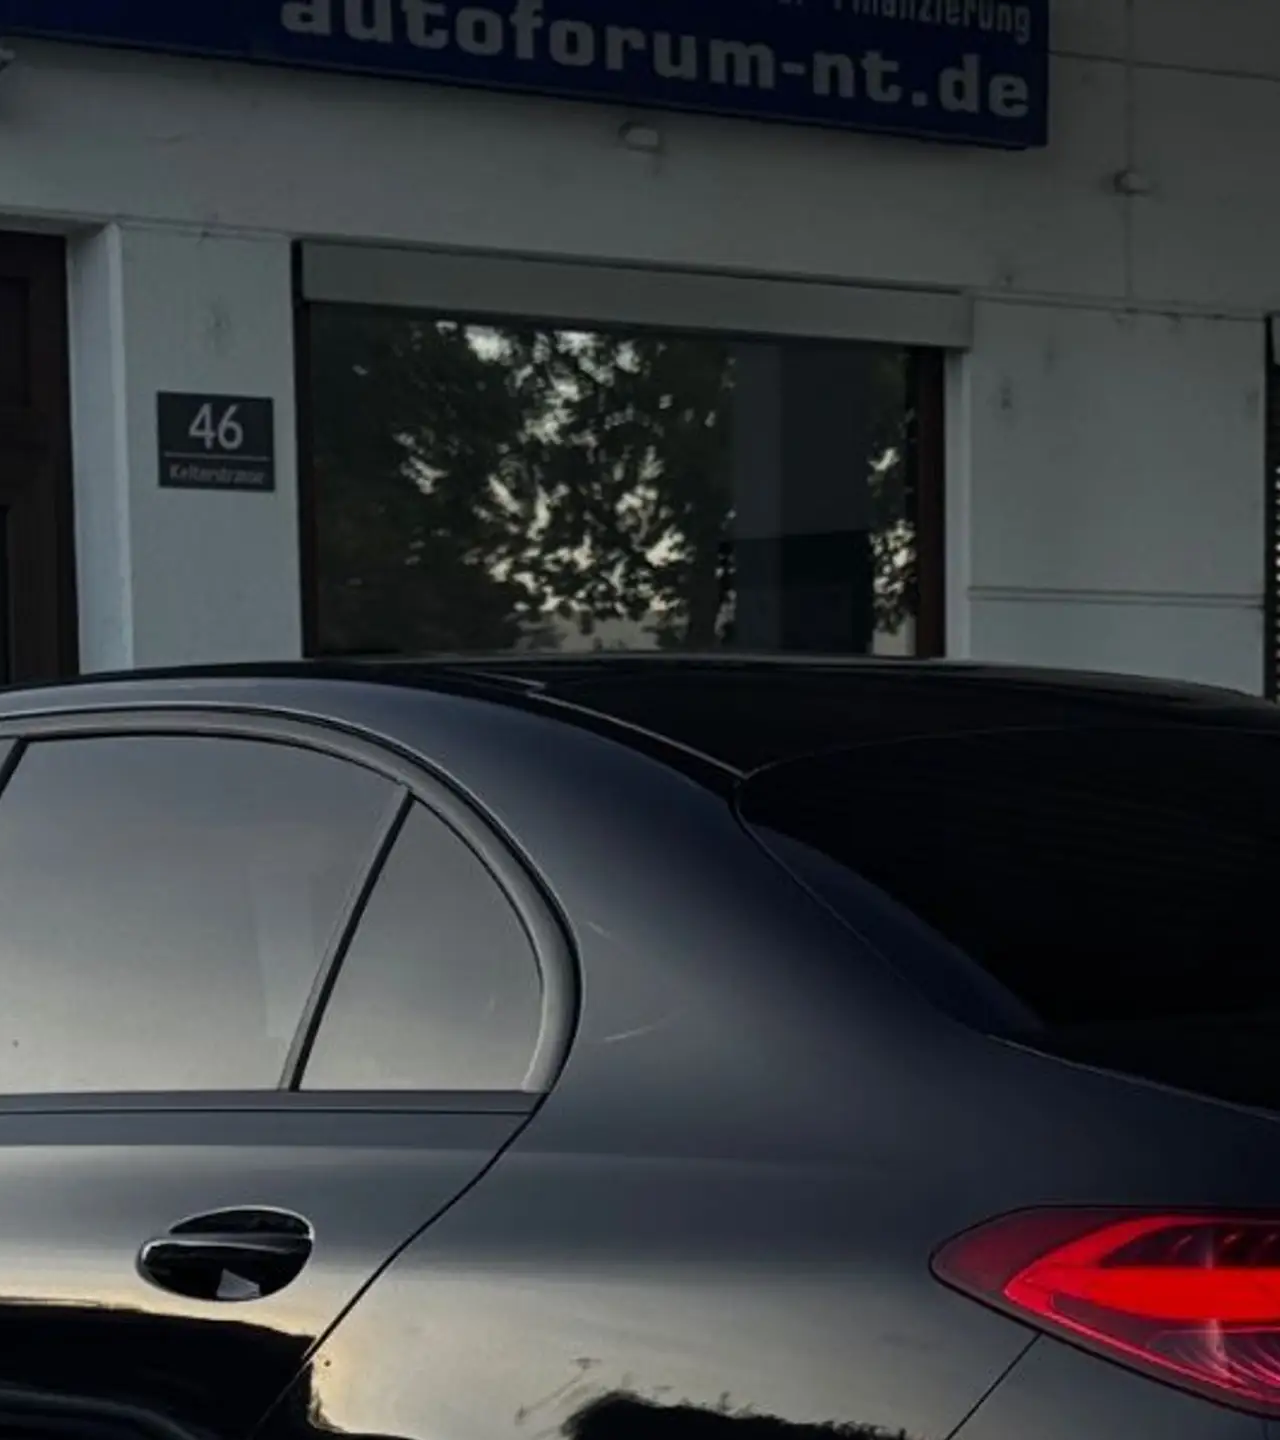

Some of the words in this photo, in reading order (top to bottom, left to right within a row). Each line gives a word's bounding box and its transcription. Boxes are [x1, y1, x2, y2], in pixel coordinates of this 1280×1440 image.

[833, 0, 1031, 45] nanzierung
[279, 0, 1030, 118] autoforum-nt.de
[188, 402, 244, 450] 46
